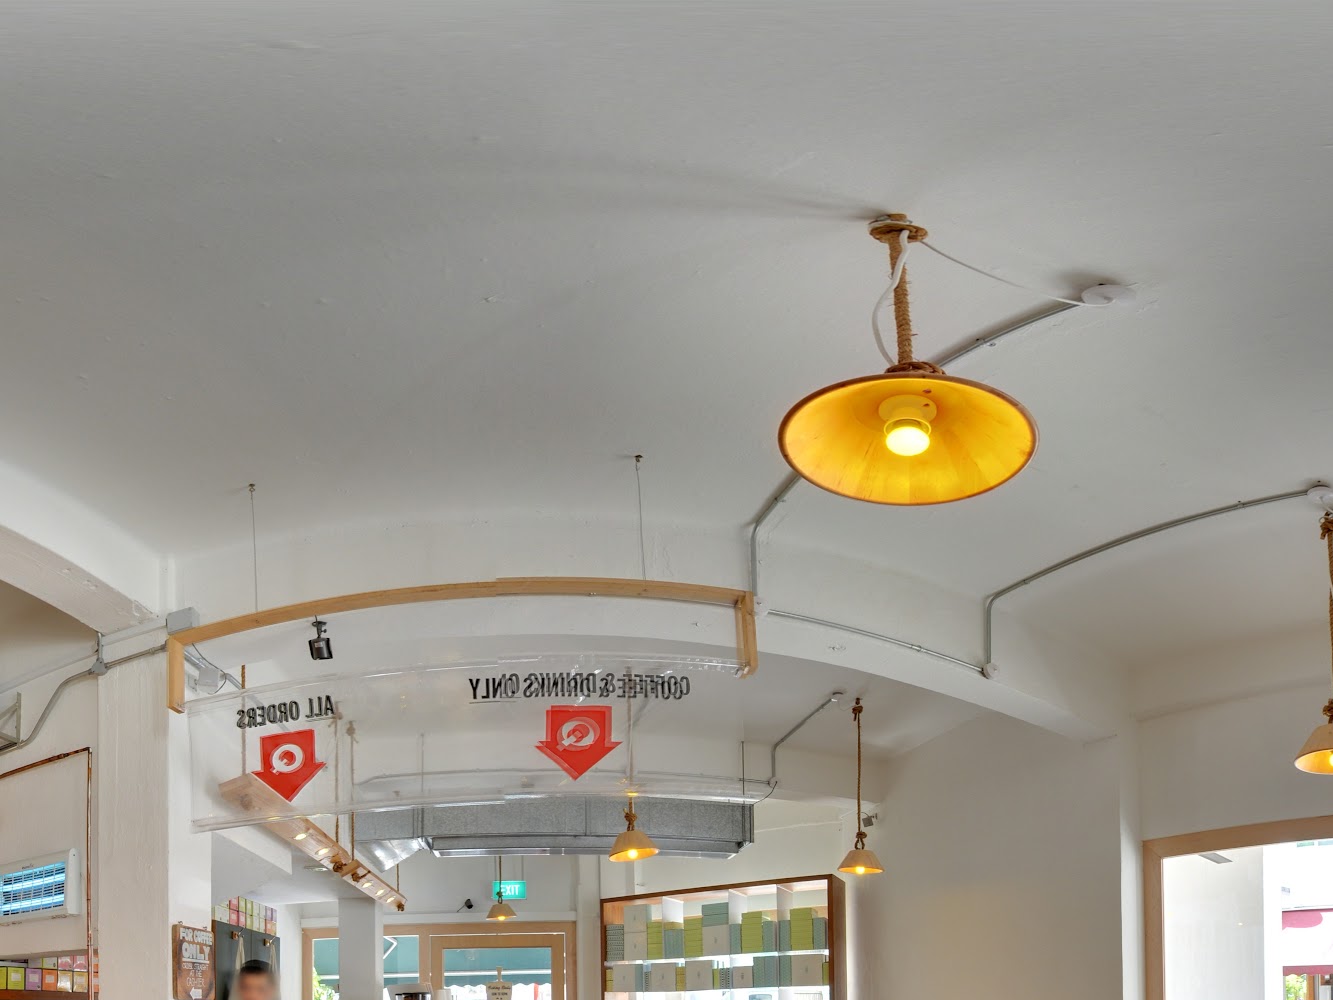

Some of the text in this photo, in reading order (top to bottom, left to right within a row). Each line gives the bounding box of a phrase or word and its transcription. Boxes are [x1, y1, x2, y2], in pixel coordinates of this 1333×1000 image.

[500, 884, 520, 896] EXIT
[180, 928, 213, 946] FOR COFFEE
[182, 941, 210, 960] ONLY
